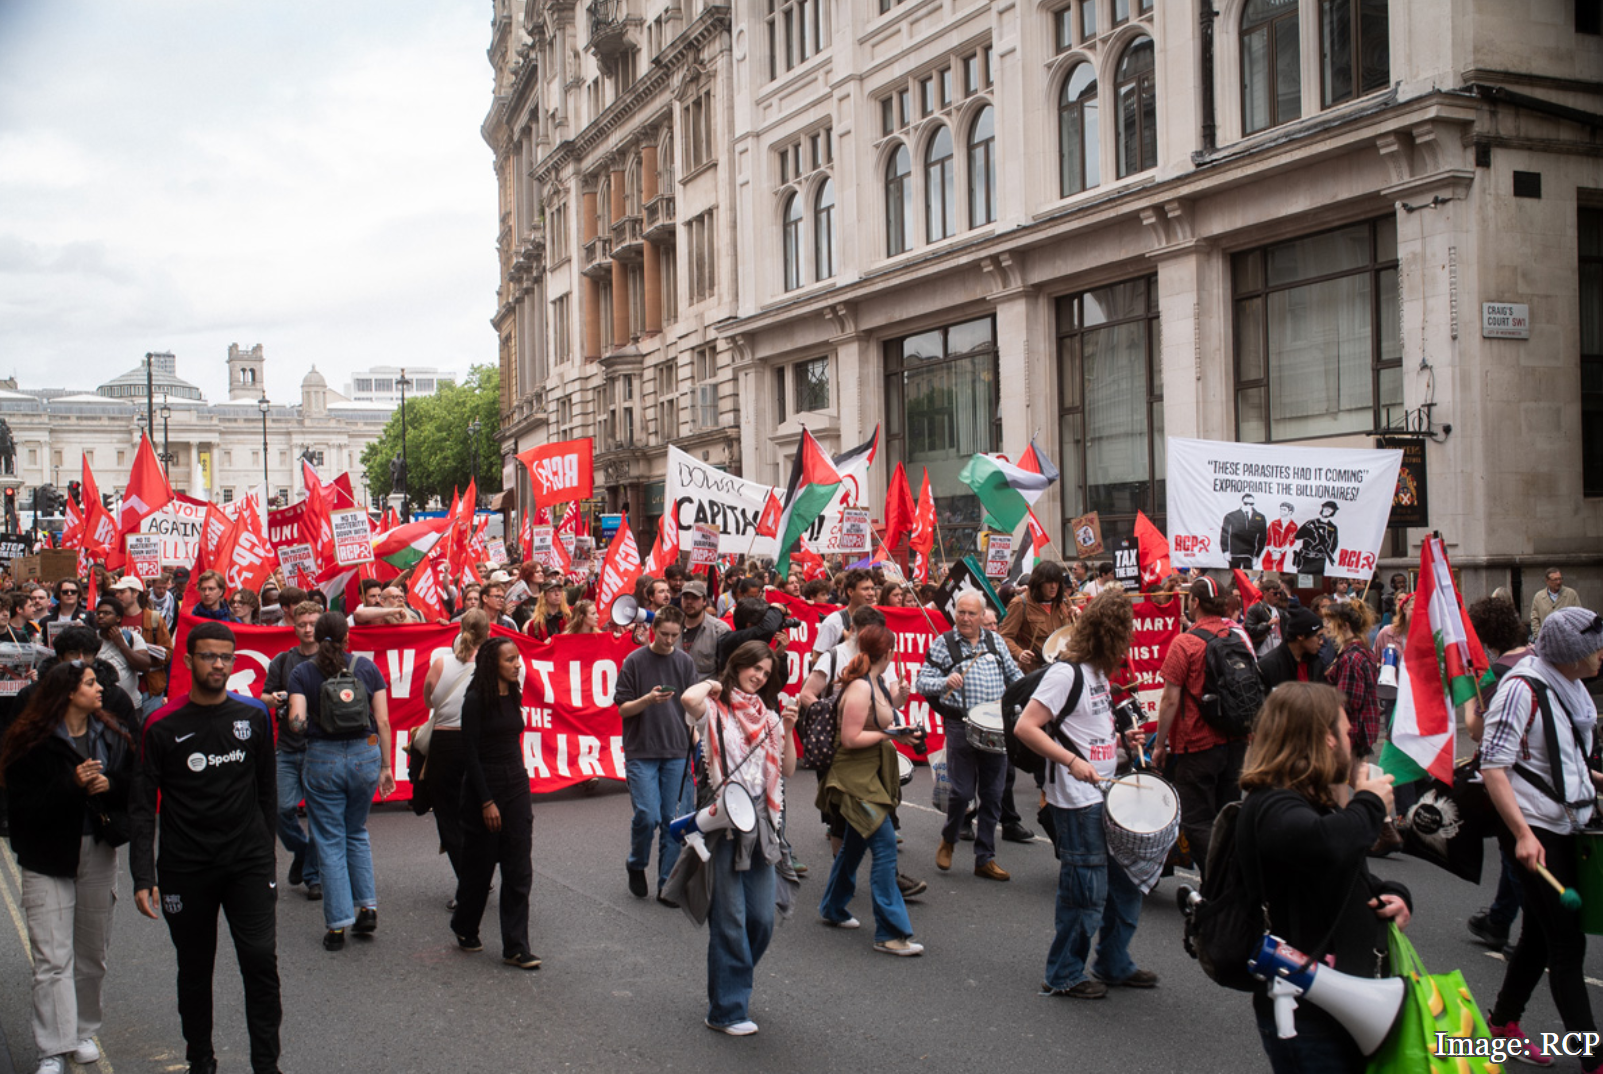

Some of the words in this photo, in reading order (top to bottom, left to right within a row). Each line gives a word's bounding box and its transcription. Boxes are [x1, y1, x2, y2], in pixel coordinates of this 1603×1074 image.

[1488, 305, 1514, 316] CRAIG'S
[1488, 316, 1509, 327] COURT
[1512, 317, 1526, 327] SW1
[1208, 460, 1241, 477] "THESE
[1242, 463, 1291, 480] PARASITES
[1292, 466, 1311, 480] HAD
[1314, 467, 1323, 481] IT
[1325, 468, 1369, 483] COMING"
[1213, 478, 1273, 494] EXPROPRIATE
[1276, 482, 1293, 496] THE
[1295, 484, 1360, 502] BILLIONAIRES!
[148, 516, 202, 538] AGAIN
[0, 541, 26, 551] STOP
[1174, 534, 1199, 552] RCP
[339, 544, 360, 561] RCP
[1115, 549, 1138, 567] TAX
[1338, 548, 1362, 569] RCI
[1115, 568, 1126, 578] THE
[789, 621, 808, 643] NO
[1131, 616, 1176, 632] NARY
[520, 706, 553, 729] THE
[207, 749, 247, 767] Spotify
